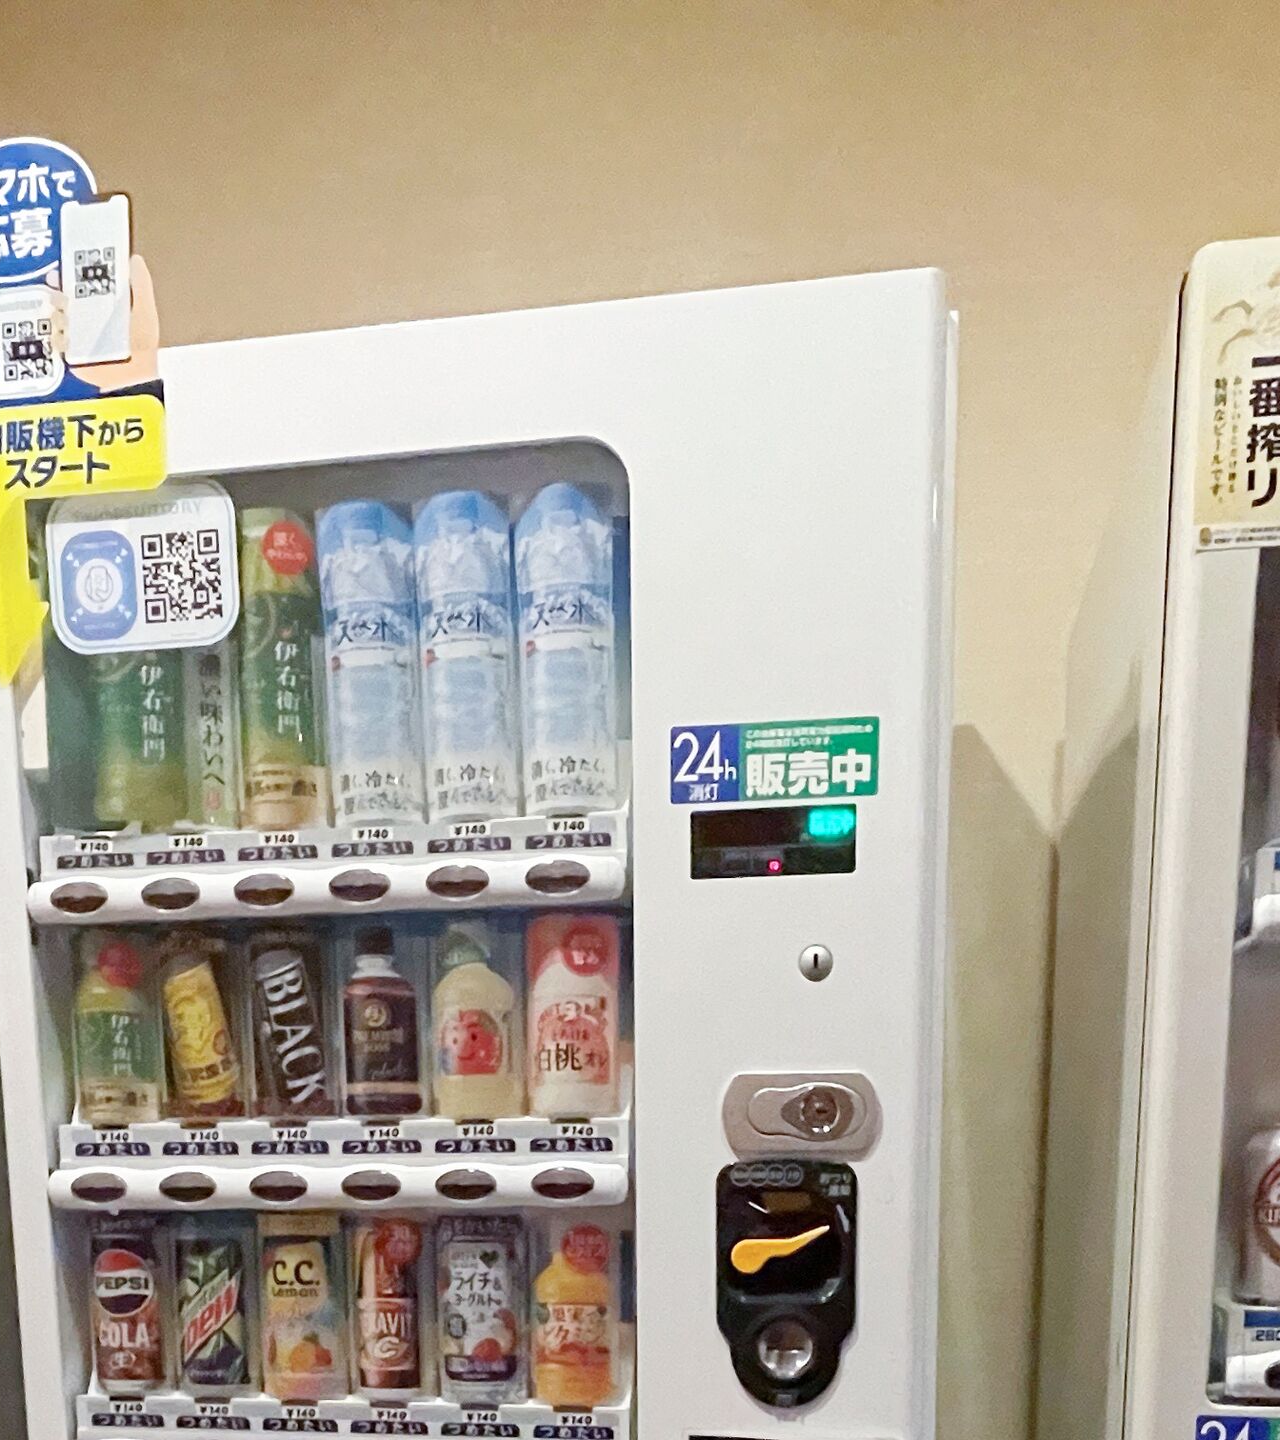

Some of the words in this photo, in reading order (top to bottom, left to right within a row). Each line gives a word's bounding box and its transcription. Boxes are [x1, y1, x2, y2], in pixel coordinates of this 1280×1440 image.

[4, 451, 111, 491] スタート
[673, 729, 738, 784] 24h
[745, 747, 872, 797] 販売中
[454, 824, 487, 836] ¥140
[552, 819, 586, 831] ¥140
[264, 833, 296, 845] ¥140
[357, 828, 389, 840] ¥140
[80, 840, 110, 853] ¥140
[173, 836, 204, 848] ¥140
[261, 967, 327, 1106] BLACK
[101, 1131, 130, 1142] ¥140
[190, 1131, 220, 1142] ¥140
[277, 1129, 308, 1141] ¥140
[369, 1127, 400, 1139] ¥140
[462, 1125, 494, 1137] ¥140
[561, 1125, 594, 1137] ¥140
[272, 1259, 321, 1286] C.C.
[96, 1276, 150, 1292] PEPSI
[271, 1286, 320, 1299] Lemon
[98, 1322, 151, 1349] COLA
[114, 1403, 143, 1413] ¥140
[200, 1405, 229, 1416] ¥140
[287, 1407, 316, 1418] ¥140
[377, 1410, 407, 1420] ¥140
[467, 1412, 498, 1423] ¥140
[561, 1415, 592, 1426] ¥140
